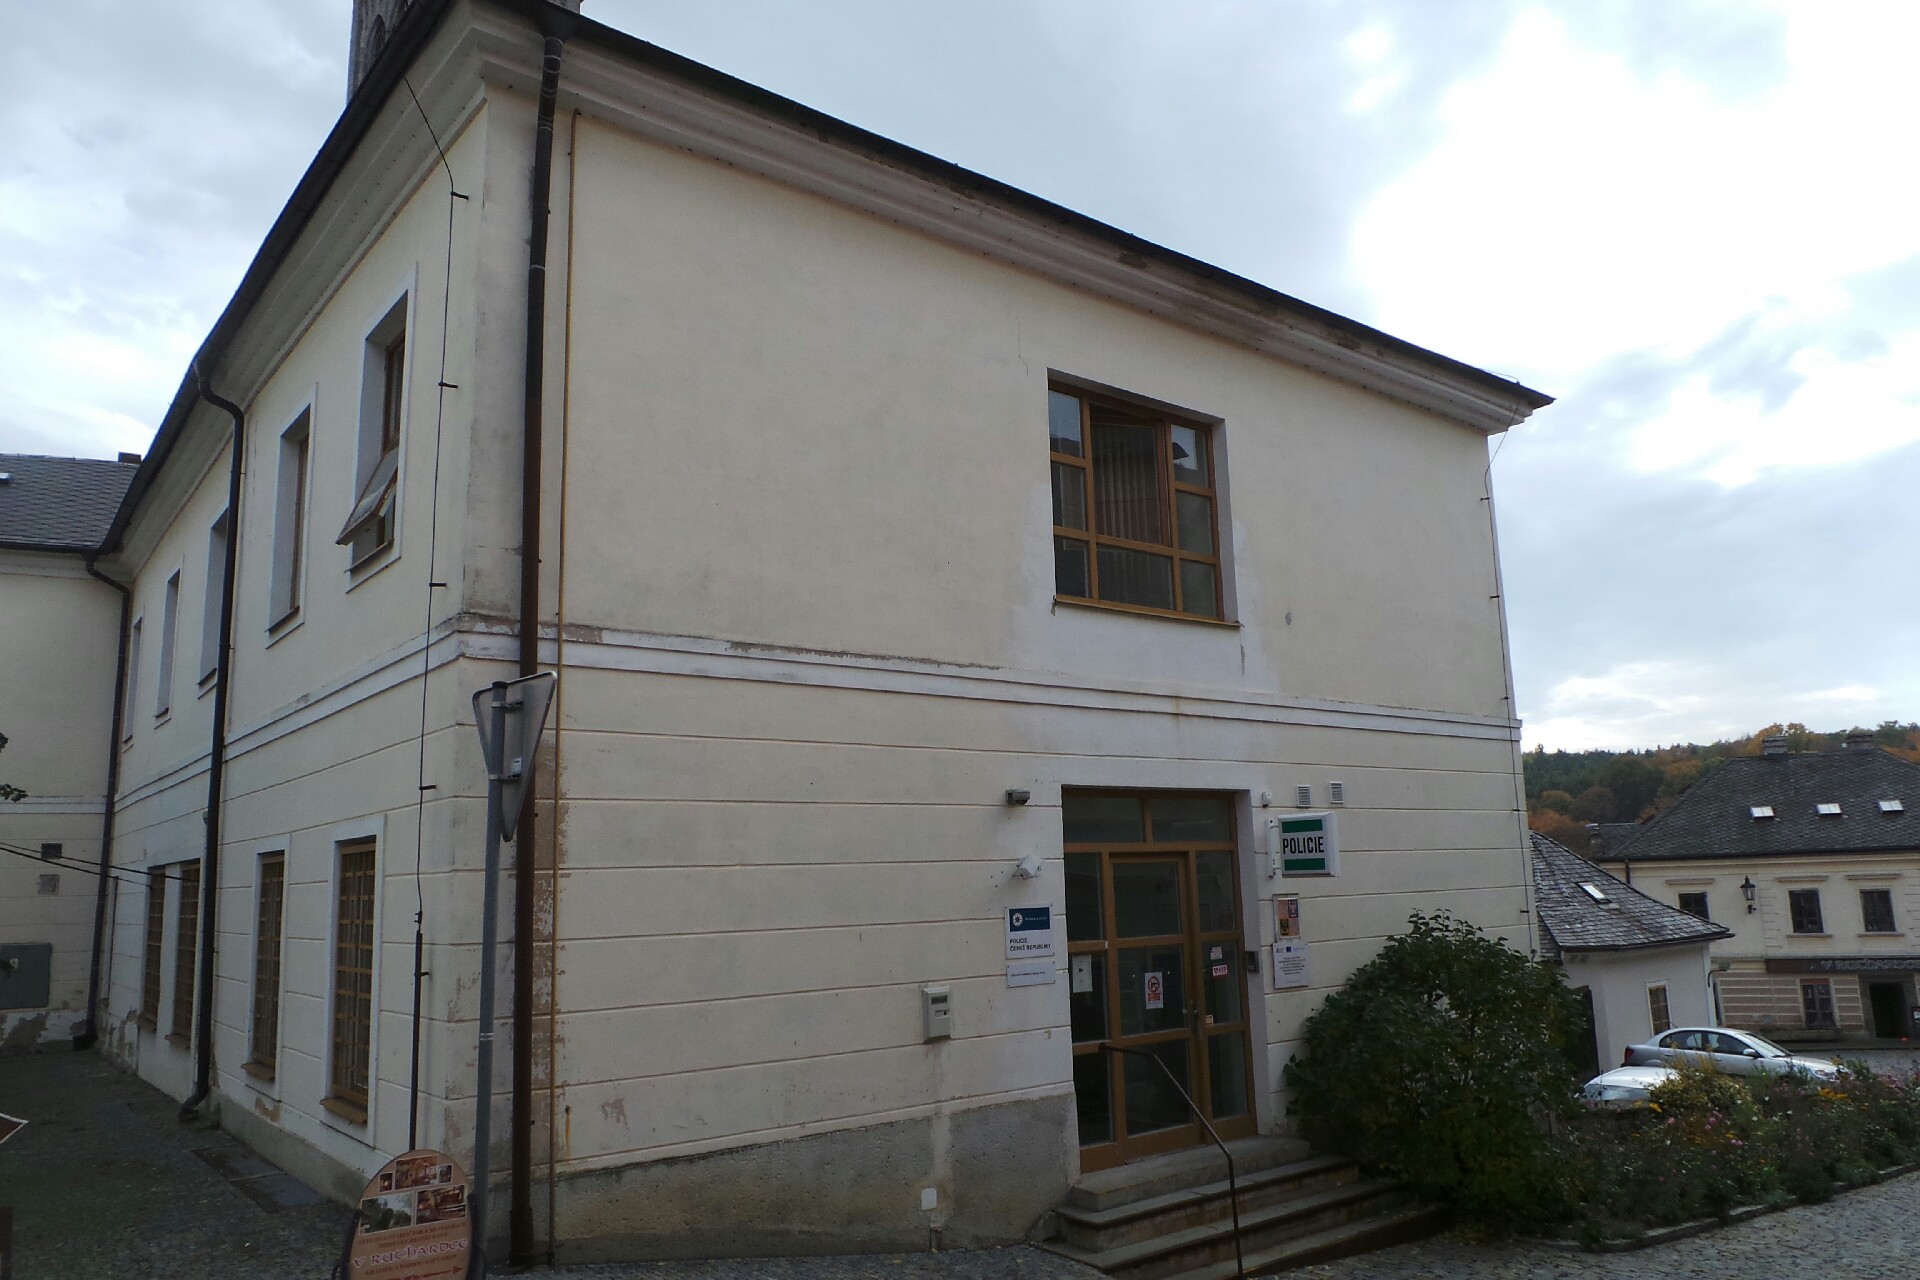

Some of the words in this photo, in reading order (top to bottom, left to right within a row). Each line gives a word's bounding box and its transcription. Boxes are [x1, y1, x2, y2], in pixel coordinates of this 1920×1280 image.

[1282, 836, 1325, 855] POLICIE
[1009, 944, 1026, 952] ČESKÉ
[1026, 943, 1051, 951] REPUBLIKY
[353, 1256, 365, 1268] V
